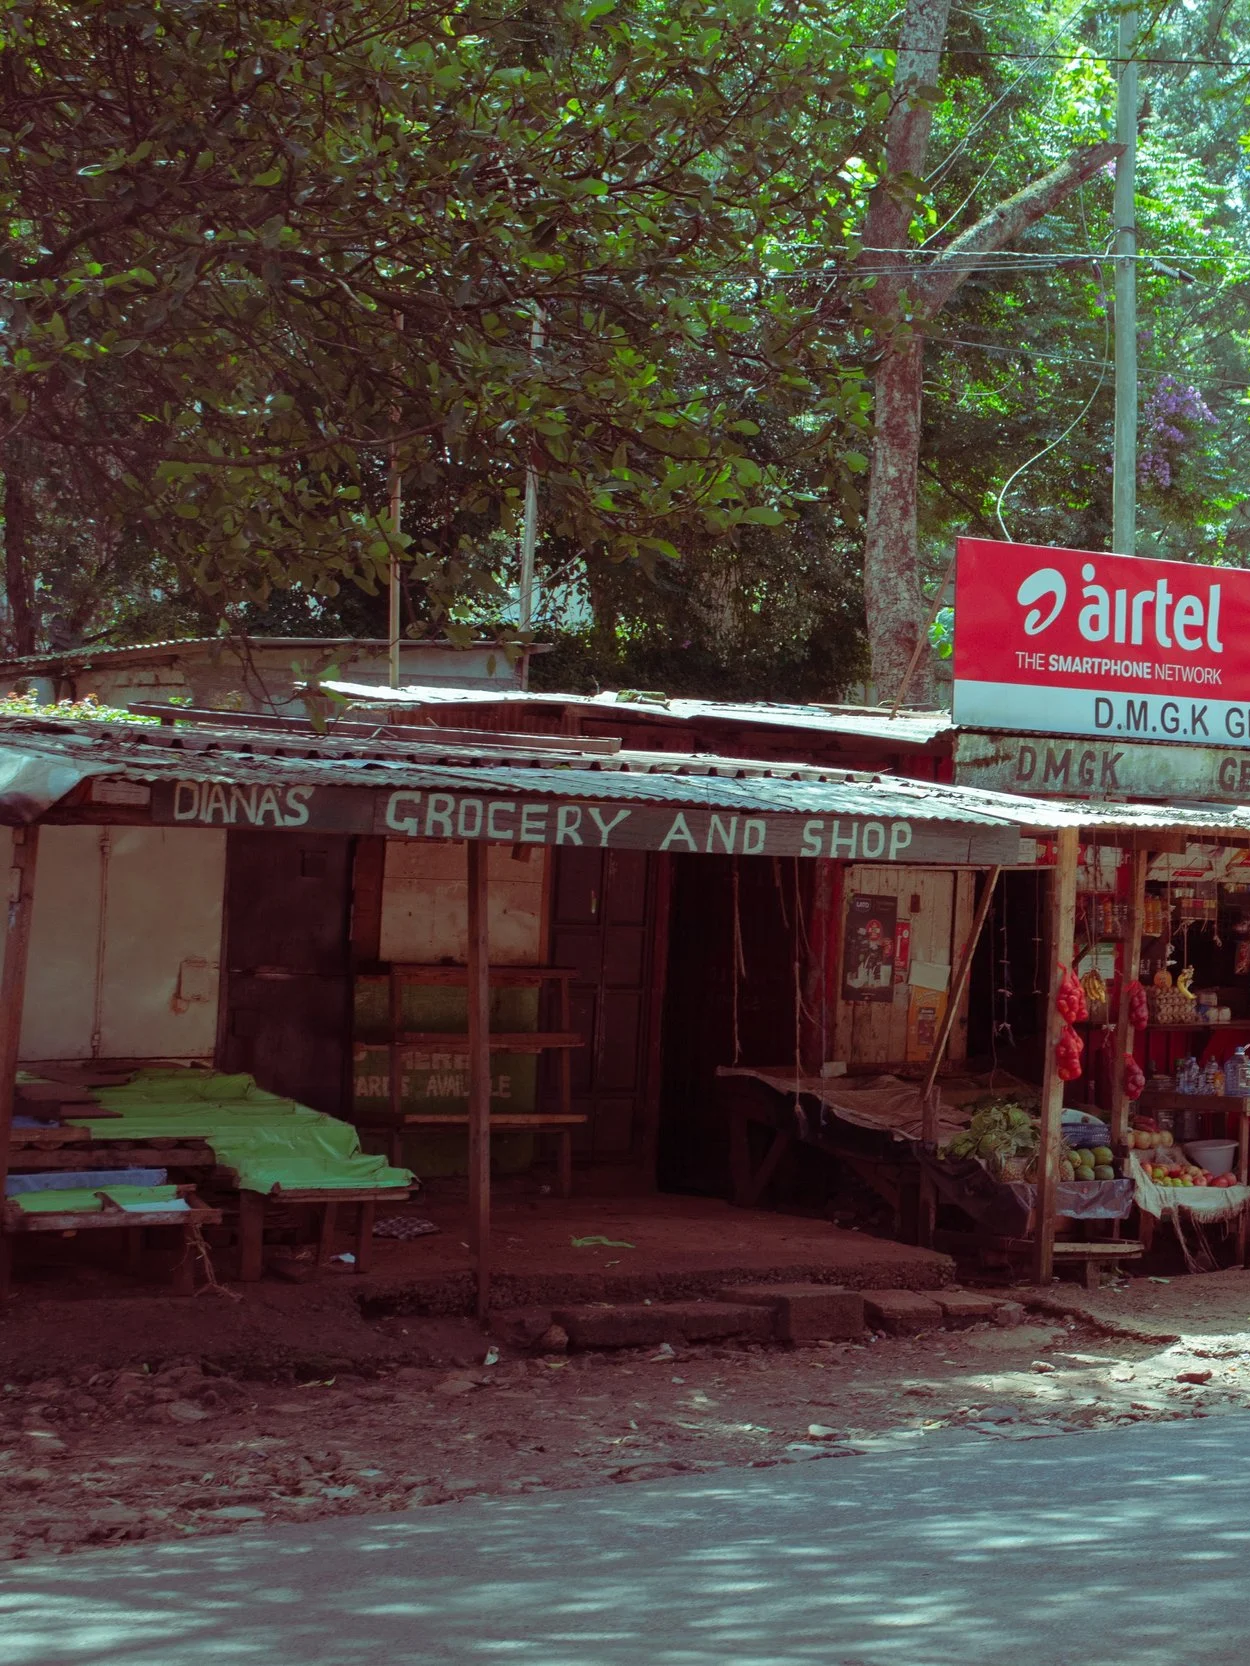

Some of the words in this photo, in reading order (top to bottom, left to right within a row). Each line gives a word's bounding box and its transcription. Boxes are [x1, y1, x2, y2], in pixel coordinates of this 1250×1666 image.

[1078, 563, 1224, 654] airtel
[1015, 651, 1045, 672] THE
[1048, 653, 1152, 680] SMARTPHONE
[1154, 664, 1223, 685] NETWORK
[1095, 698, 1210, 738] D.M.G.K
[385, 790, 632, 847] GROCERY
[660, 811, 766, 856] AND
[804, 819, 914, 862] SHOP
